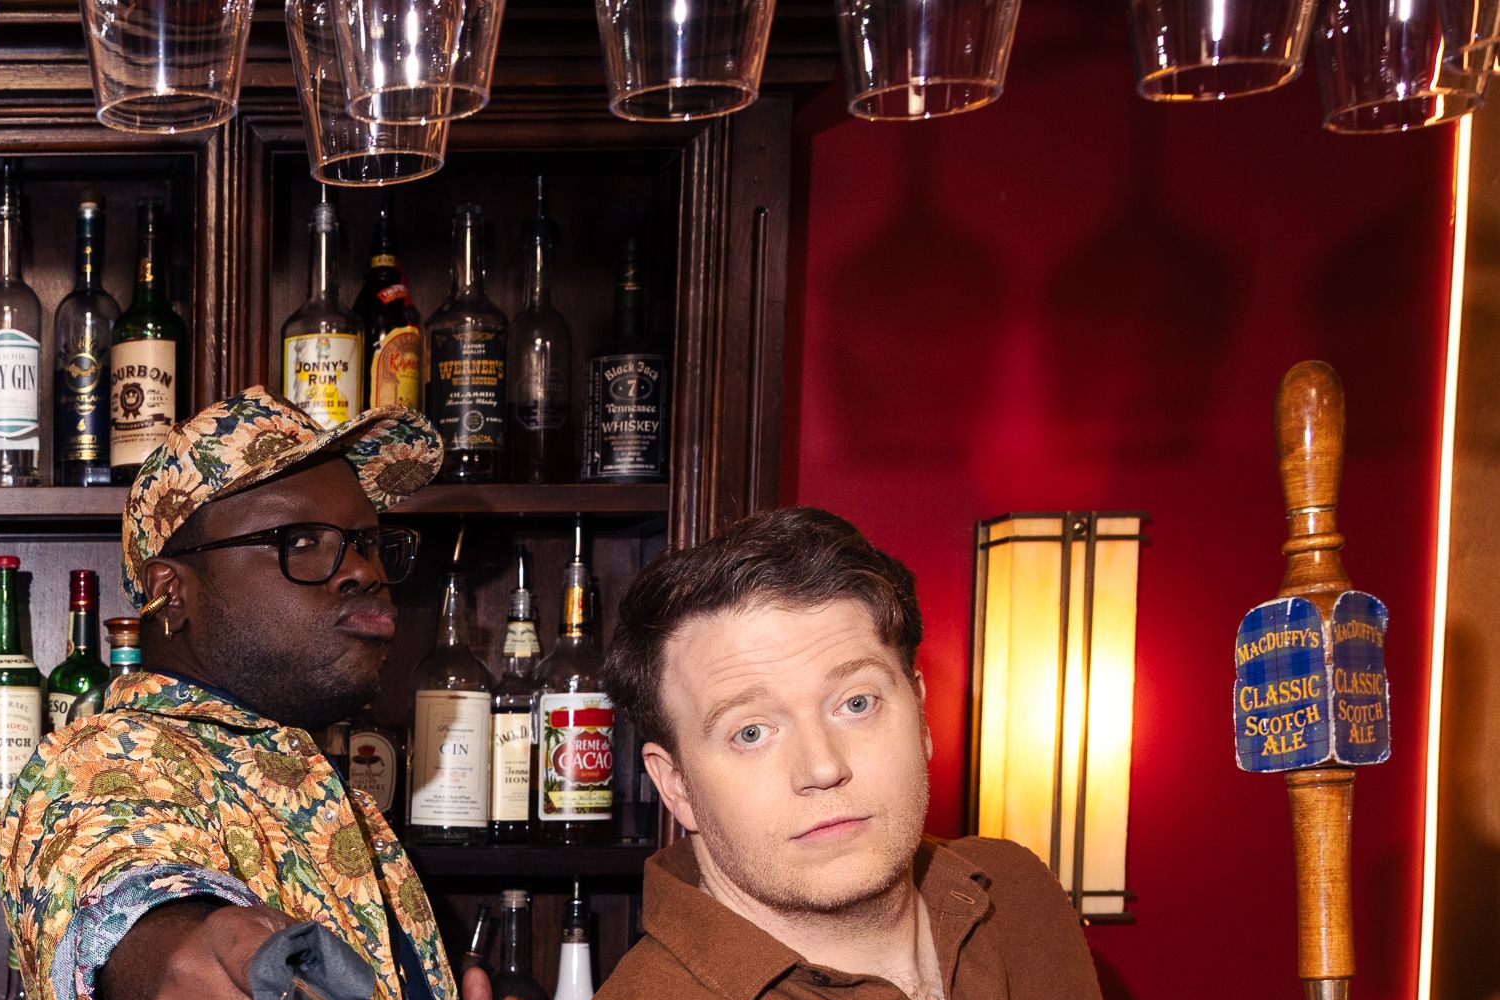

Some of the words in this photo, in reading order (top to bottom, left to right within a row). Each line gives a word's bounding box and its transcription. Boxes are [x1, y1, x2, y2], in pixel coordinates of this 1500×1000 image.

[296, 359, 349, 373] JONNY'S
[438, 360, 504, 380] WERNER'S
[604, 361, 634, 381] Black
[637, 361, 659, 381] Jack
[11, 365, 36, 391] GIN
[308, 374, 337, 386] RUM
[627, 379, 637, 397] 7
[605, 403, 657, 414] Tennessee
[602, 420, 659, 433] WHISKEY
[1334, 667, 1384, 696] CLASSIC
[1239, 675, 1321, 712] CLASSIC
[1244, 703, 1321, 737] SCOTCH
[1338, 699, 1383, 725] SCOTCH
[571, 740, 599, 750] REME
[1261, 730, 1308, 757] ALE
[1348, 725, 1377, 745] ALE
[558, 752, 612, 770] CACAO
